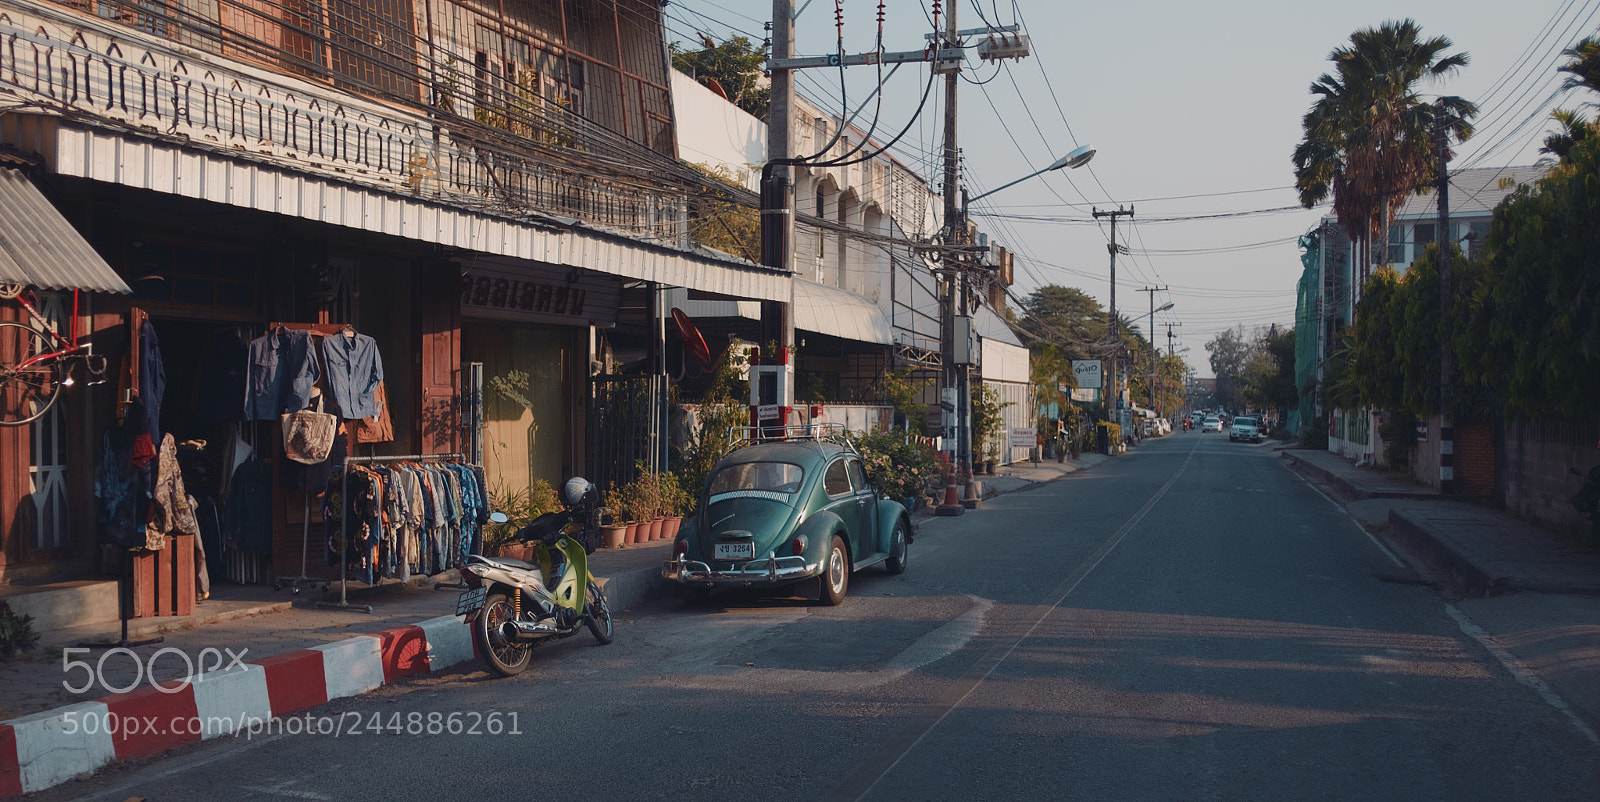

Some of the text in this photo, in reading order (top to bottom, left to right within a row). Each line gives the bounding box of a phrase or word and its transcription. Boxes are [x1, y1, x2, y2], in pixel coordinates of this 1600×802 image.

[830, 56, 839, 65] C
[868, 54, 877, 63] B
[733, 545, 750, 553] 3264
